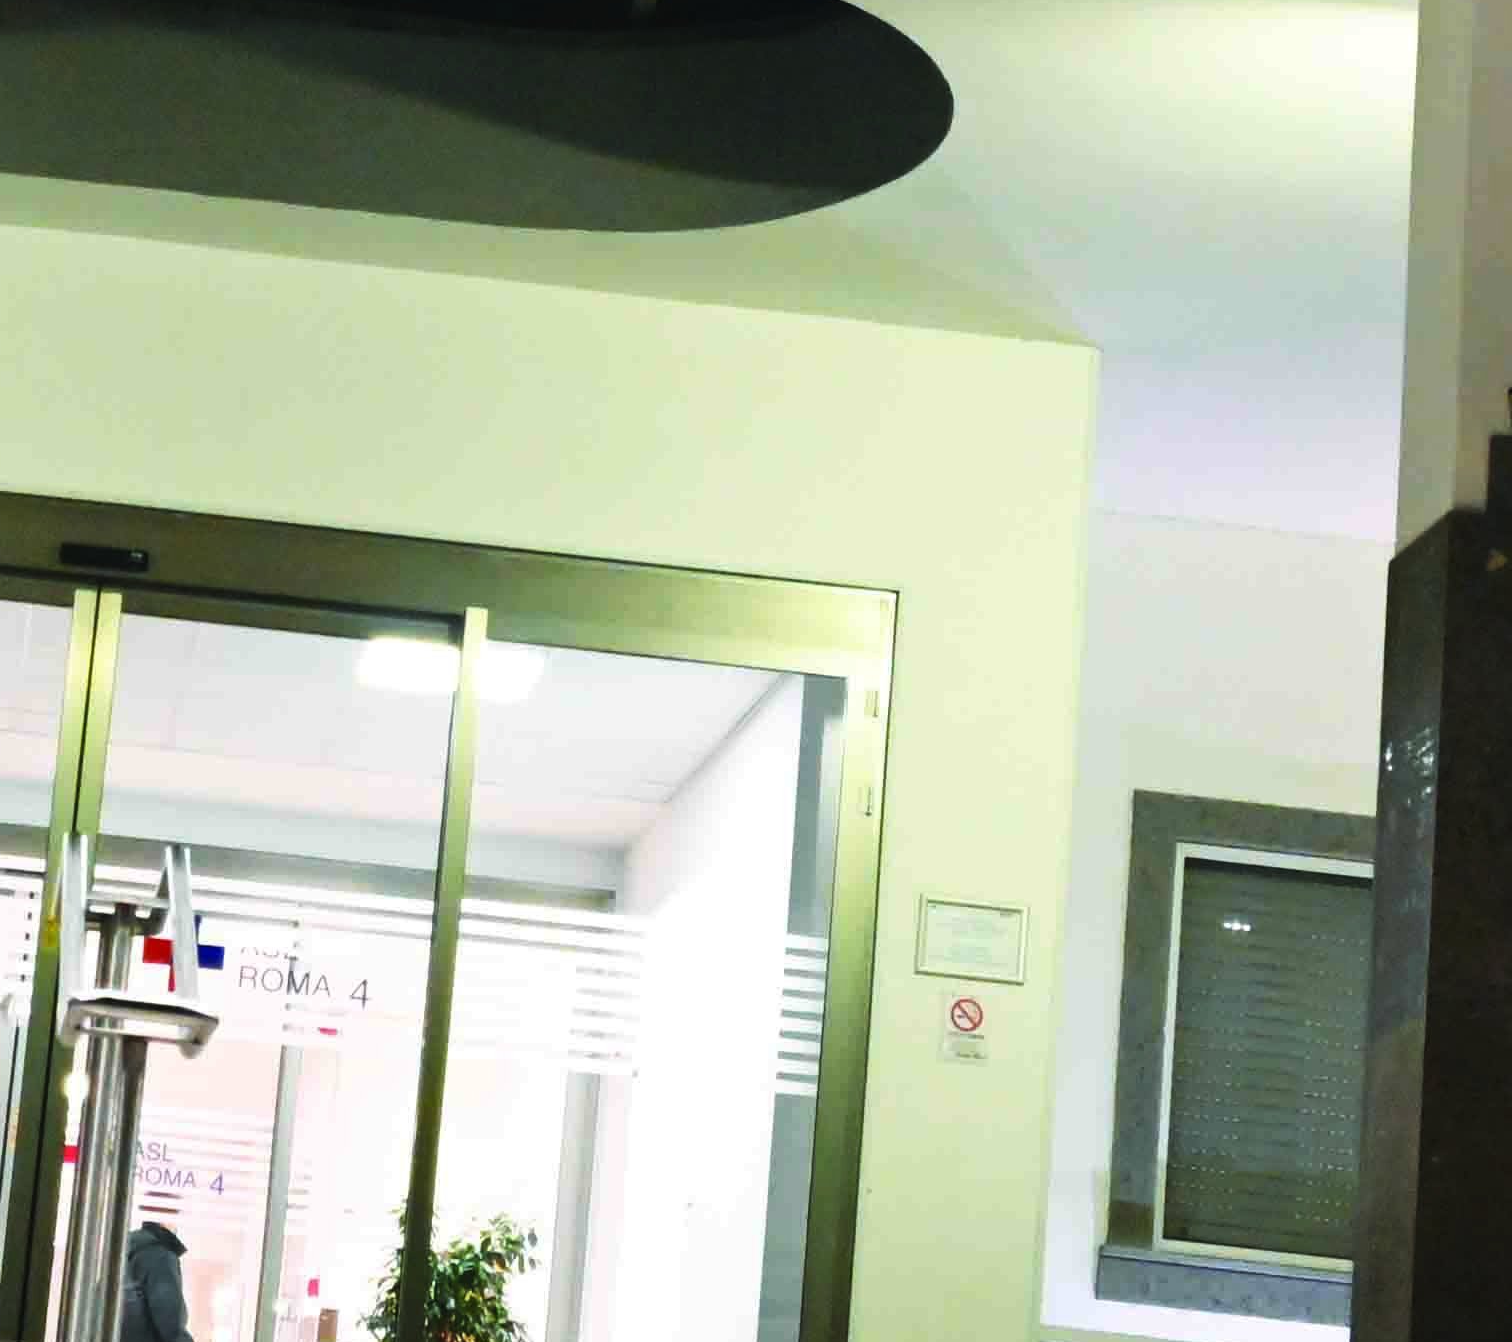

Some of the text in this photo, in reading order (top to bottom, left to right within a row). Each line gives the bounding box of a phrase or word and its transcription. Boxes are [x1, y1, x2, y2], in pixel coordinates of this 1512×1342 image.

[239, 965, 370, 1009] ROMA 4
[209, 1173, 225, 1195] 4
